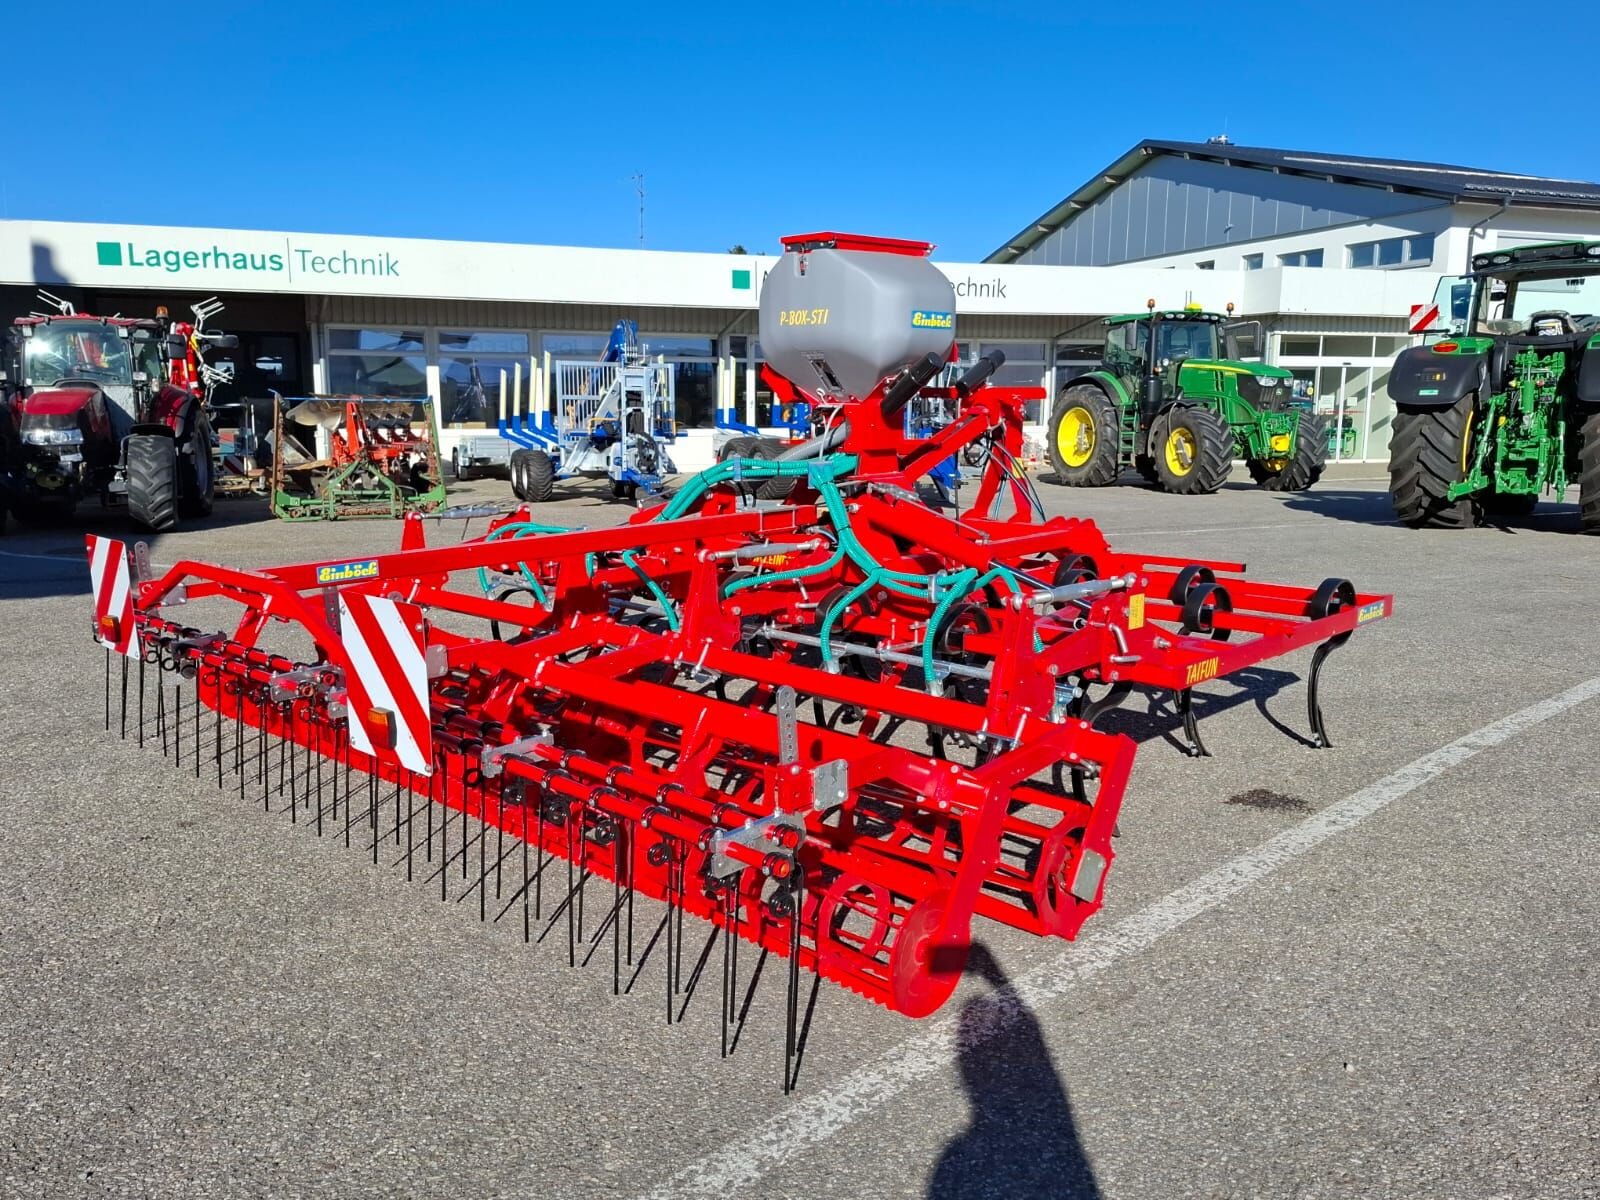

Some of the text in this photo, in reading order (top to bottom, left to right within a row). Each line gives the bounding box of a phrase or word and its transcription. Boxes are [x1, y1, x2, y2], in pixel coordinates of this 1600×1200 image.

[127, 242, 400, 277] Lagerhaus Technik
[912, 311, 953, 328] Einböck
[319, 561, 377, 582] Einböck
[1186, 655, 1219, 685] TAIFUN
